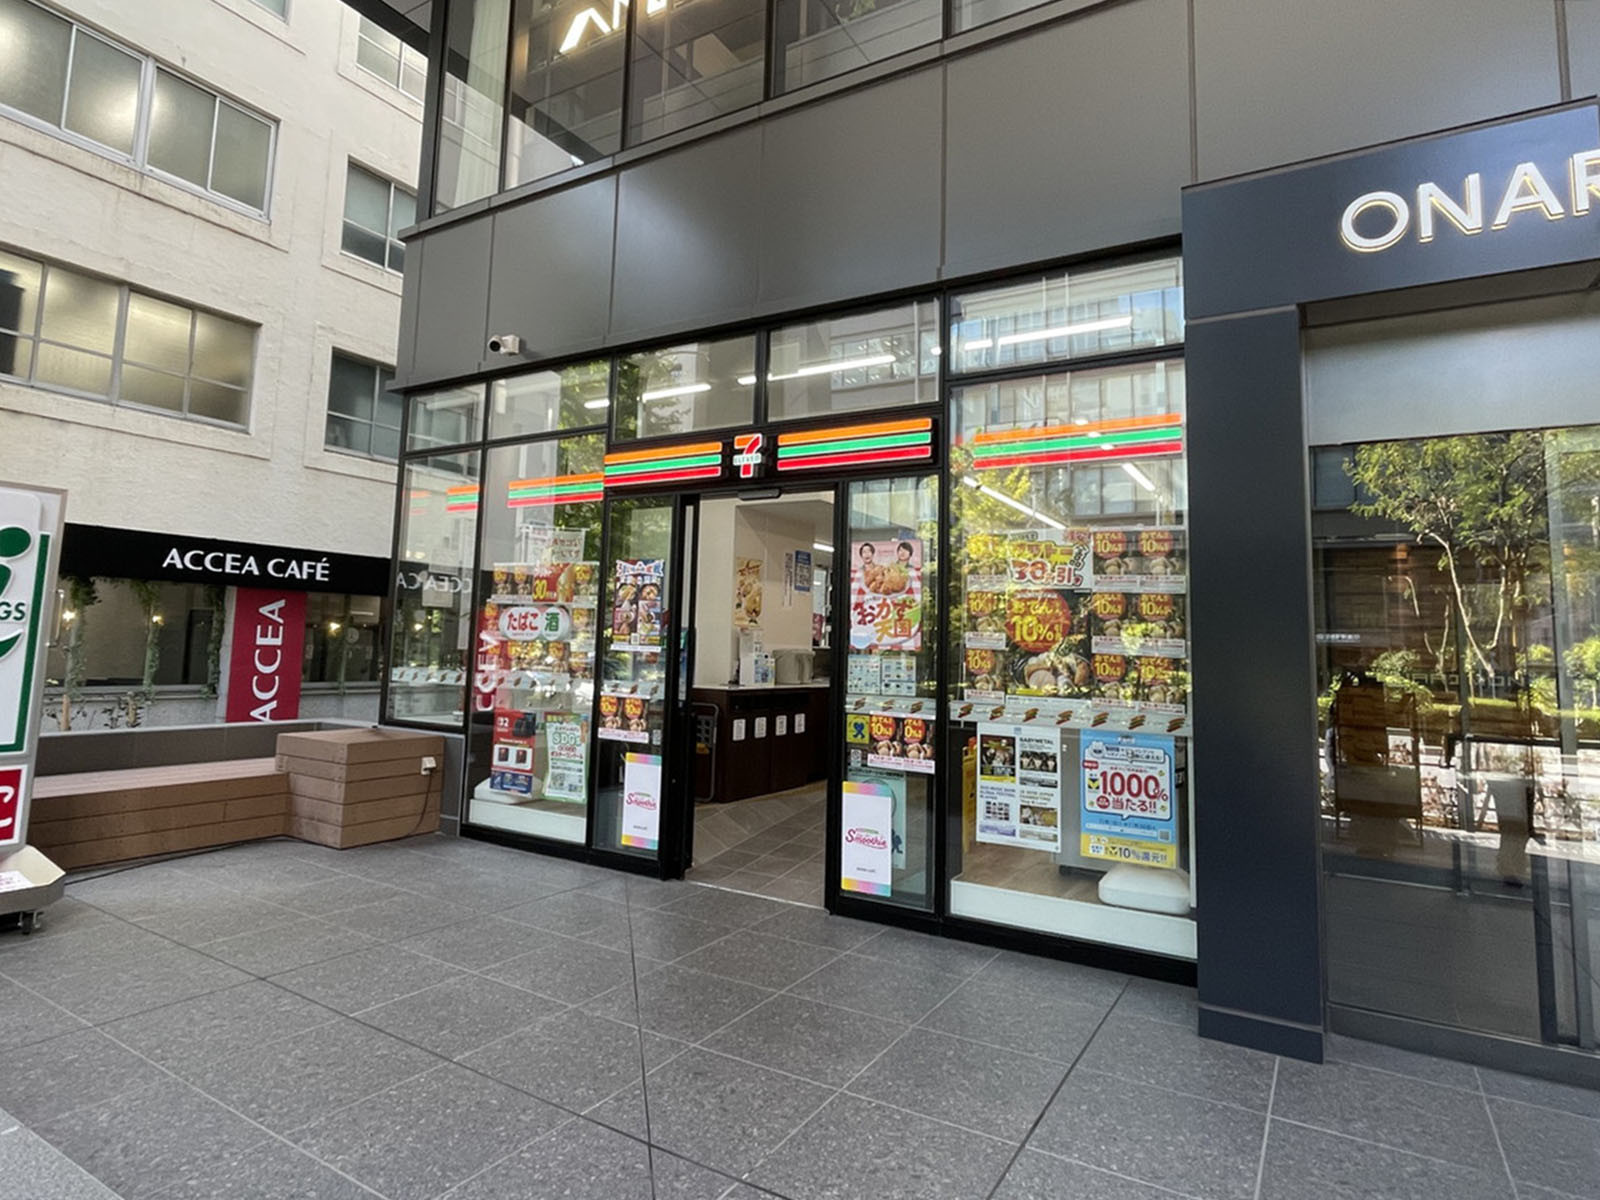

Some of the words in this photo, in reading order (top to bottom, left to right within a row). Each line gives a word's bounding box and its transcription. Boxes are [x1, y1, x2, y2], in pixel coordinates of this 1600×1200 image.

[162, 547, 260, 576] ACCEA
[267, 557, 330, 581] CAFÉ
[506, 611, 539, 631] たばこ
[544, 611, 560, 632] 酒
[873, 618, 912, 643] 天国
[249, 599, 286, 721] ACCEA
